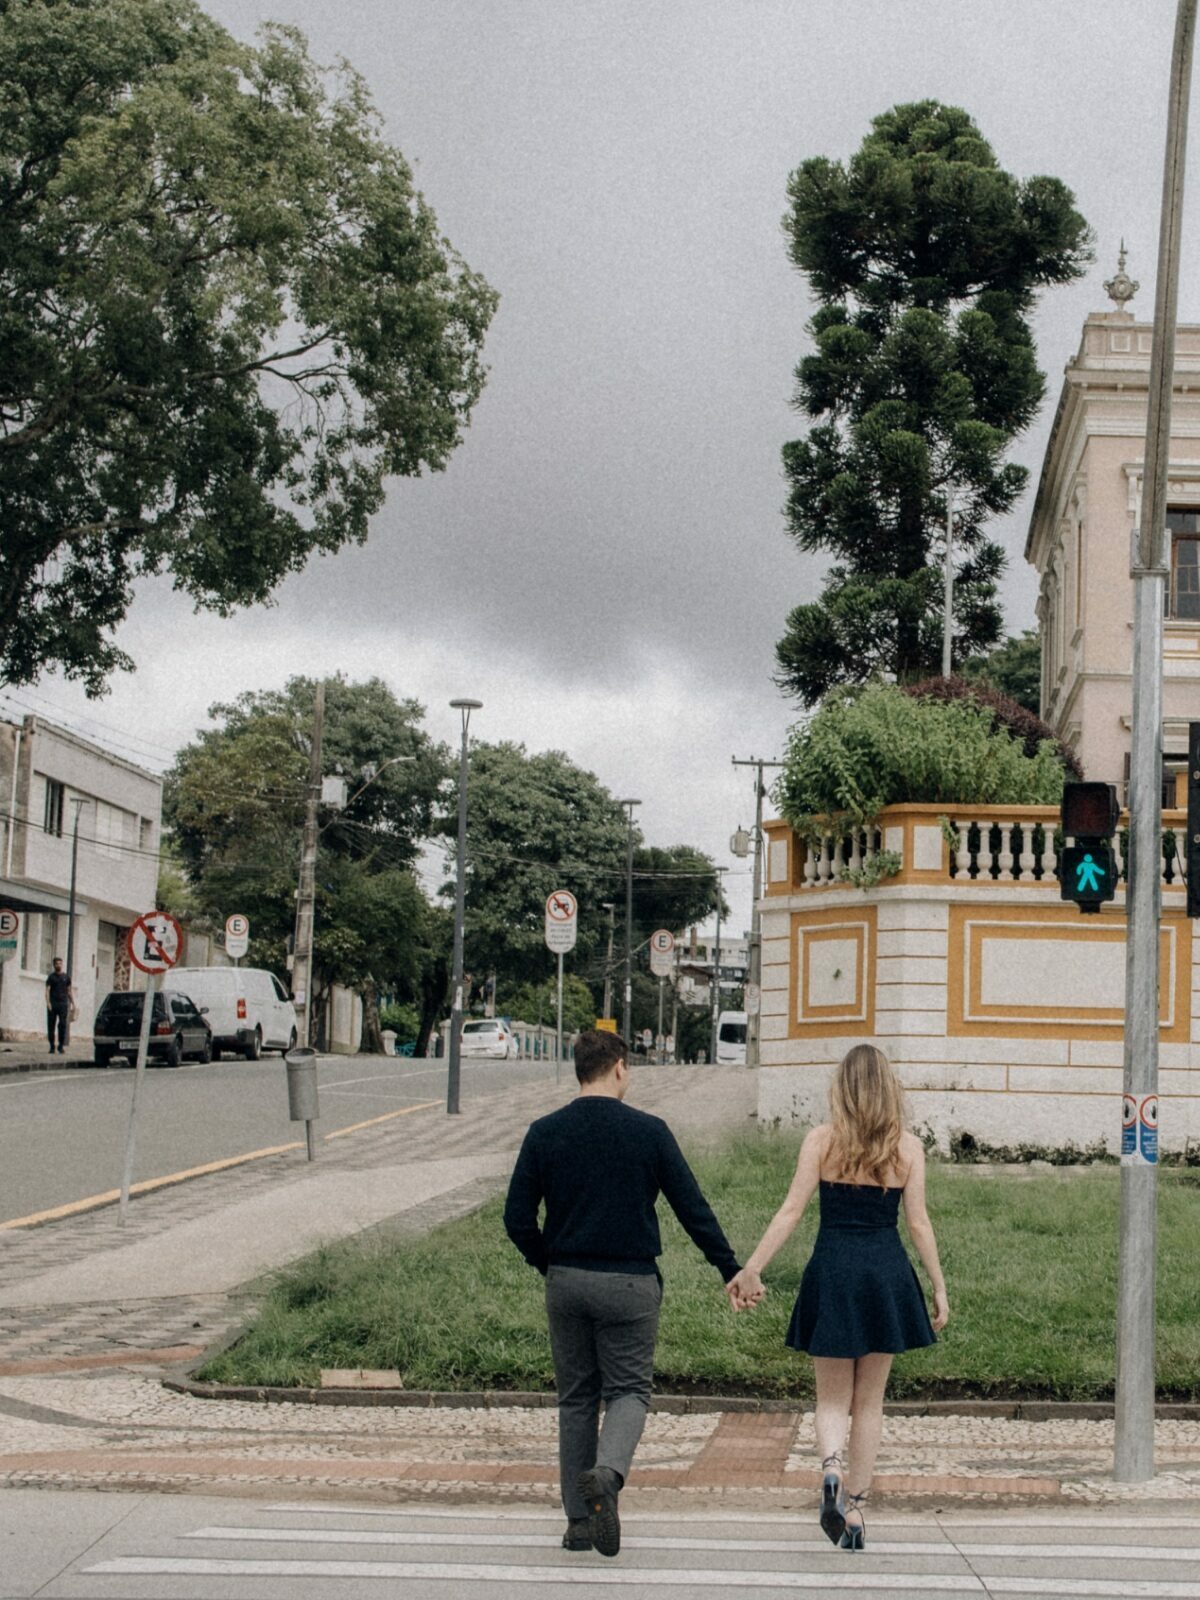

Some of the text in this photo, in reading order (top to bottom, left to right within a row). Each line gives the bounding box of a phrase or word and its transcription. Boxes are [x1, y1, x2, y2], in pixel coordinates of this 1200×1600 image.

[0, 915, 10, 930] E
[233, 919, 241, 932] E
[658, 935, 667, 948] E
